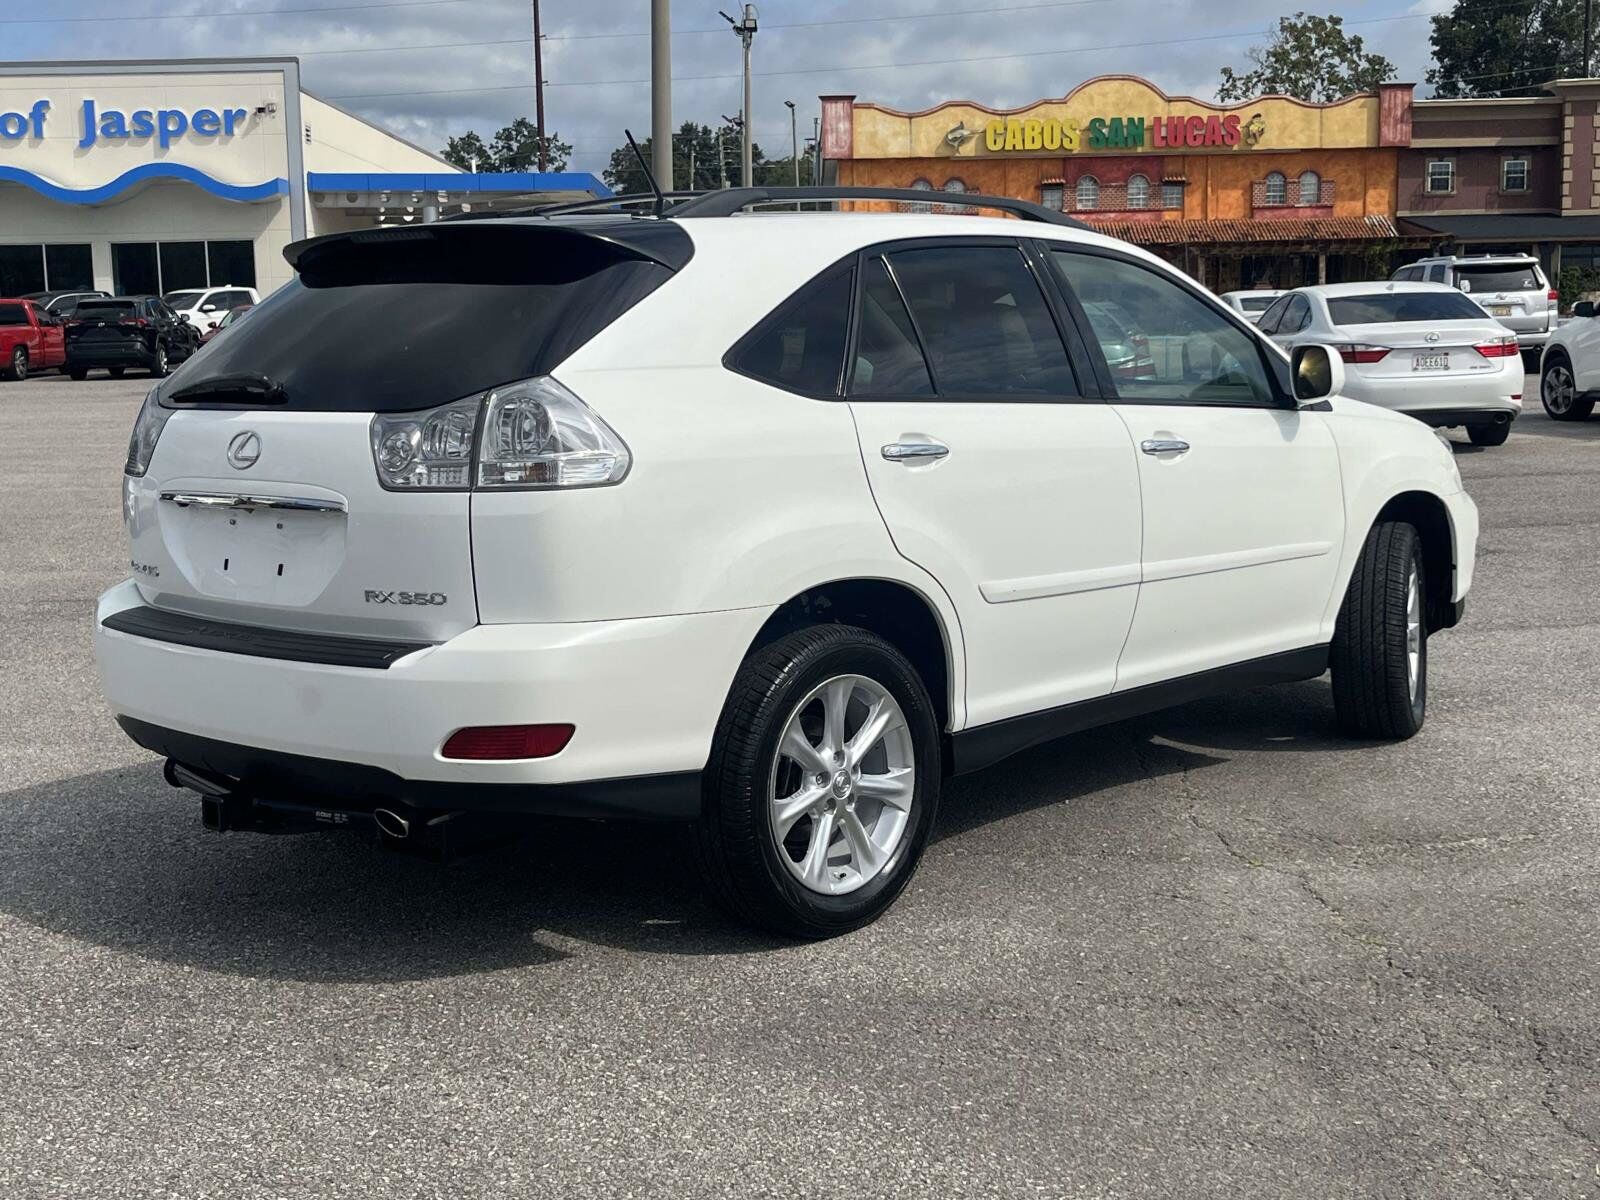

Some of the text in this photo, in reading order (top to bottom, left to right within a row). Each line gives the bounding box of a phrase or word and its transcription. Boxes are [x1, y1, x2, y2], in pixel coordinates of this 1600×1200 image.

[0, 99, 247, 150] of Jasper
[985, 114, 1242, 151] CABOS SAN LUCAS
